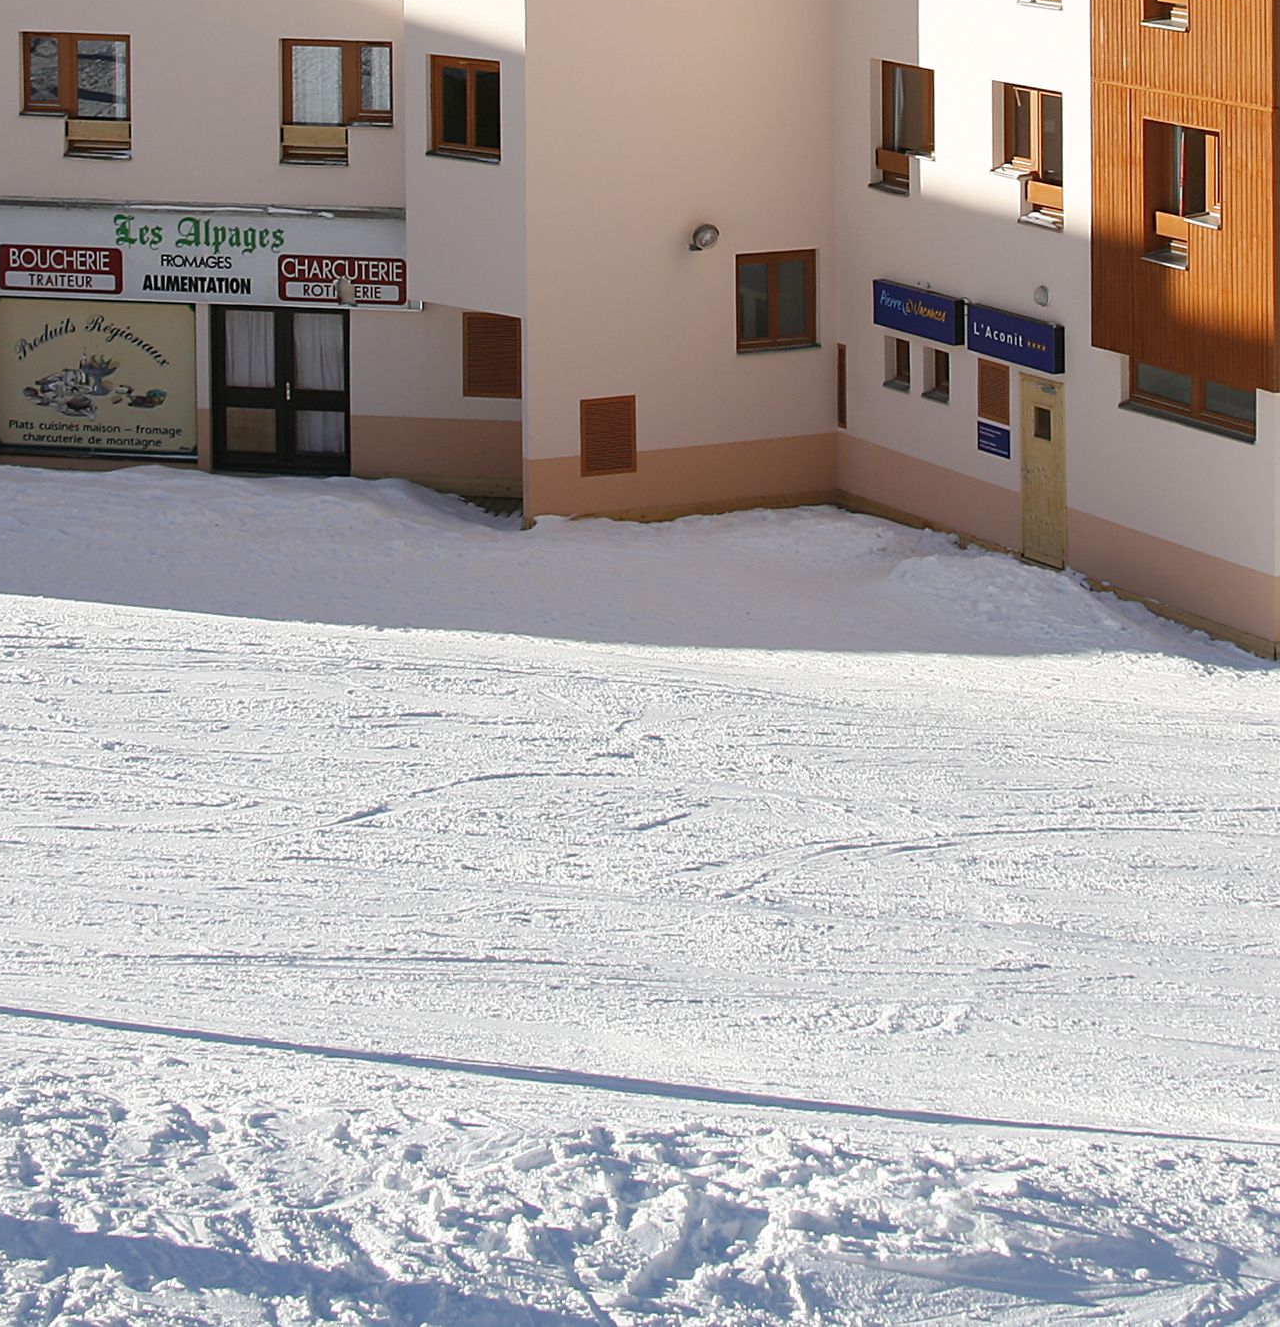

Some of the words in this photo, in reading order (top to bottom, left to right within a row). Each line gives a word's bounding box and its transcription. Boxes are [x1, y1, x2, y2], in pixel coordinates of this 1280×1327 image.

[113, 214, 163, 251] Les
[175, 216, 285, 255] Alpages
[9, 248, 110, 271] BOUCHERIE
[160, 254, 232, 269] FROMAGES
[281, 258, 403, 282] CHARCUTERIE
[28, 273, 93, 288] TRAITEUR
[142, 275, 251, 294] ALIMENTATION
[303, 284, 381, 299] ROTIERIE
[880, 289, 902, 311] Pierre
[913, 301, 947, 323] Vacances
[15, 318, 76, 360] Produits
[85, 314, 170, 367] Régionaux
[973, 321, 1023, 348] L'Aconit
[8, 419, 34, 430] Plats
[83, 424, 120, 433] maison
[136, 425, 182, 438] fromage
[23, 432, 83, 444] charcuterie
[88, 436, 102, 445] de
[106, 437, 162, 450] montagne
